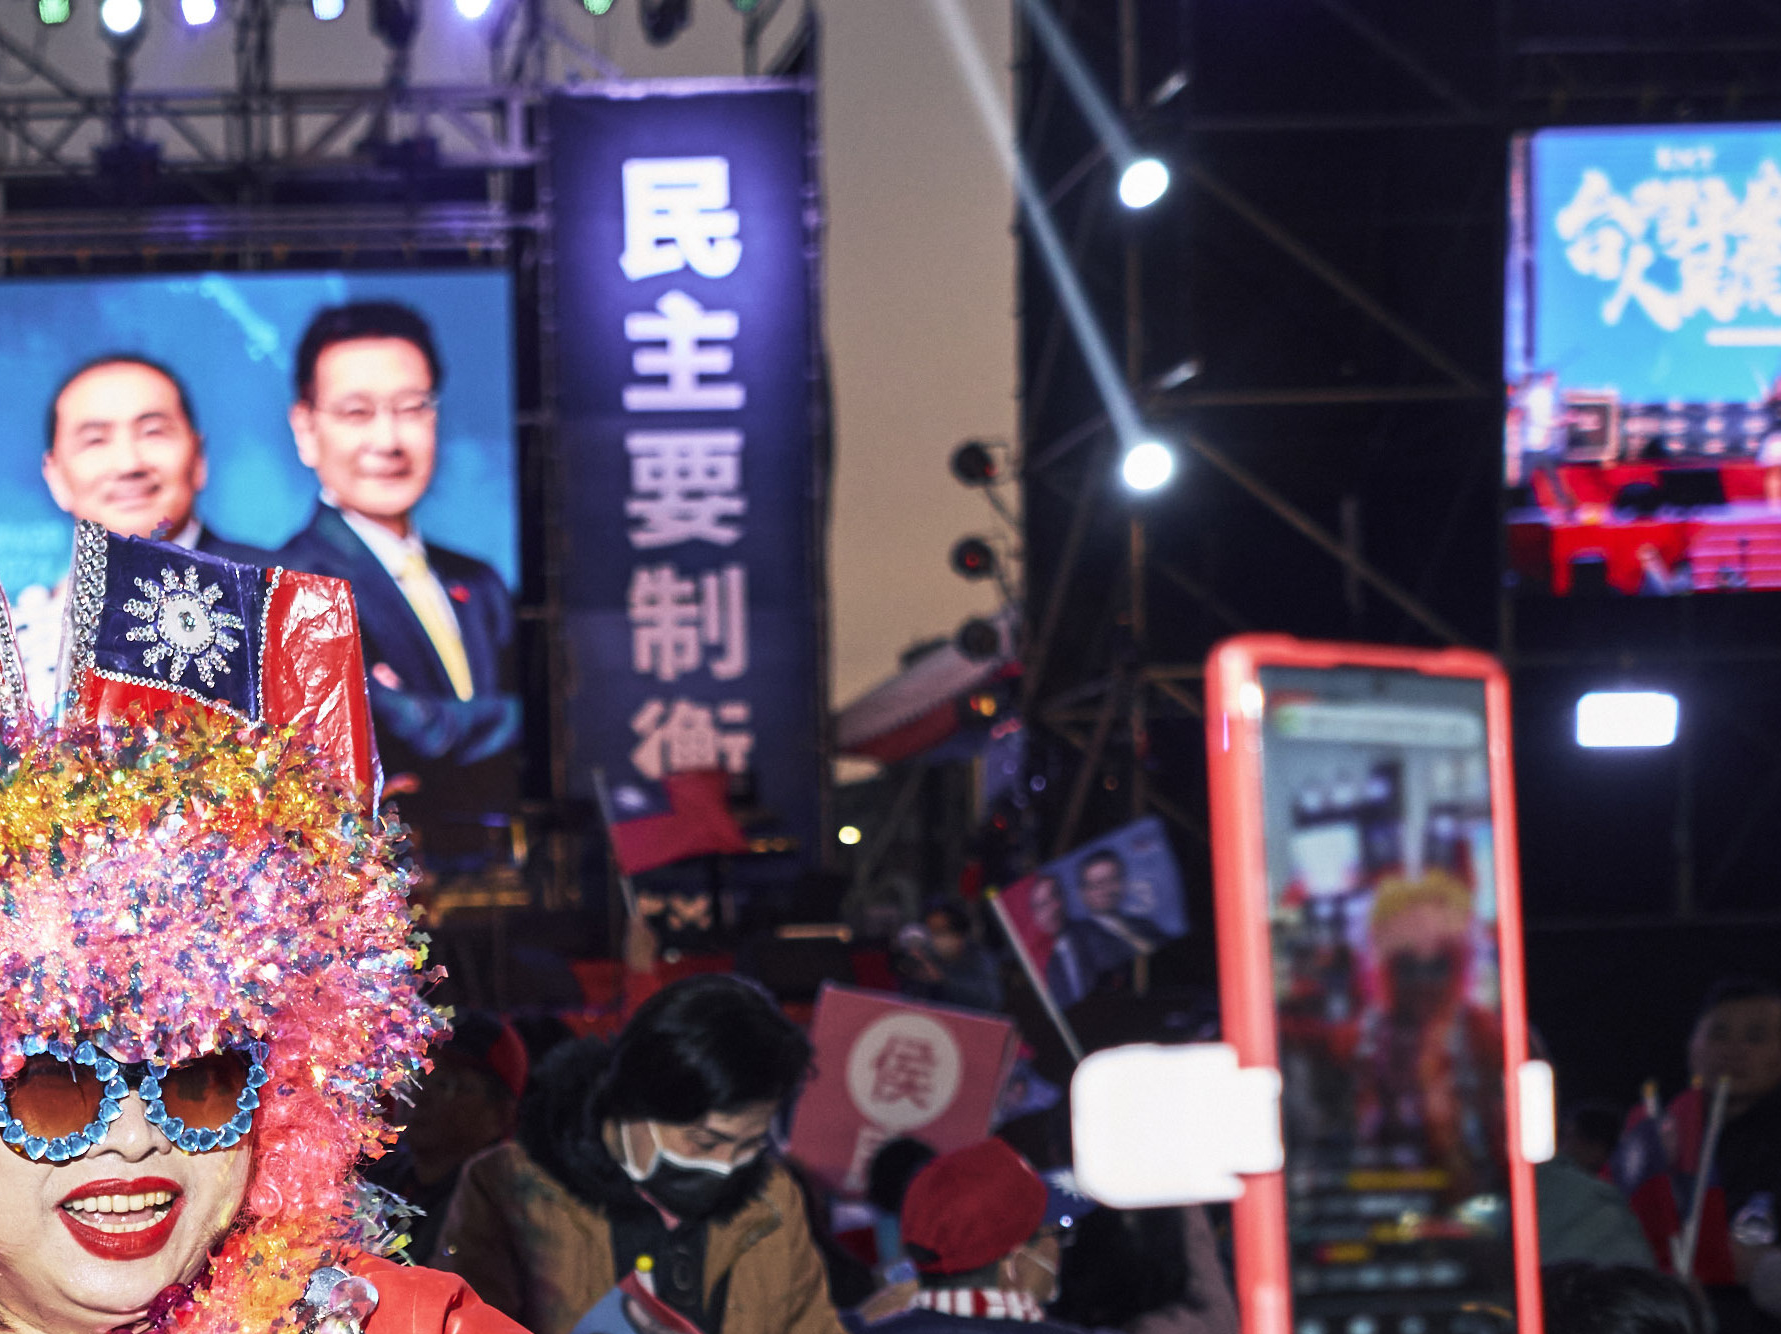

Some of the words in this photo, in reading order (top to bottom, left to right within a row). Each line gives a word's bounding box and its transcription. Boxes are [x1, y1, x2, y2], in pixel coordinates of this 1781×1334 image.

[622, 155, 753, 778] 民主要制衡
[871, 1034, 935, 1111] 侯
